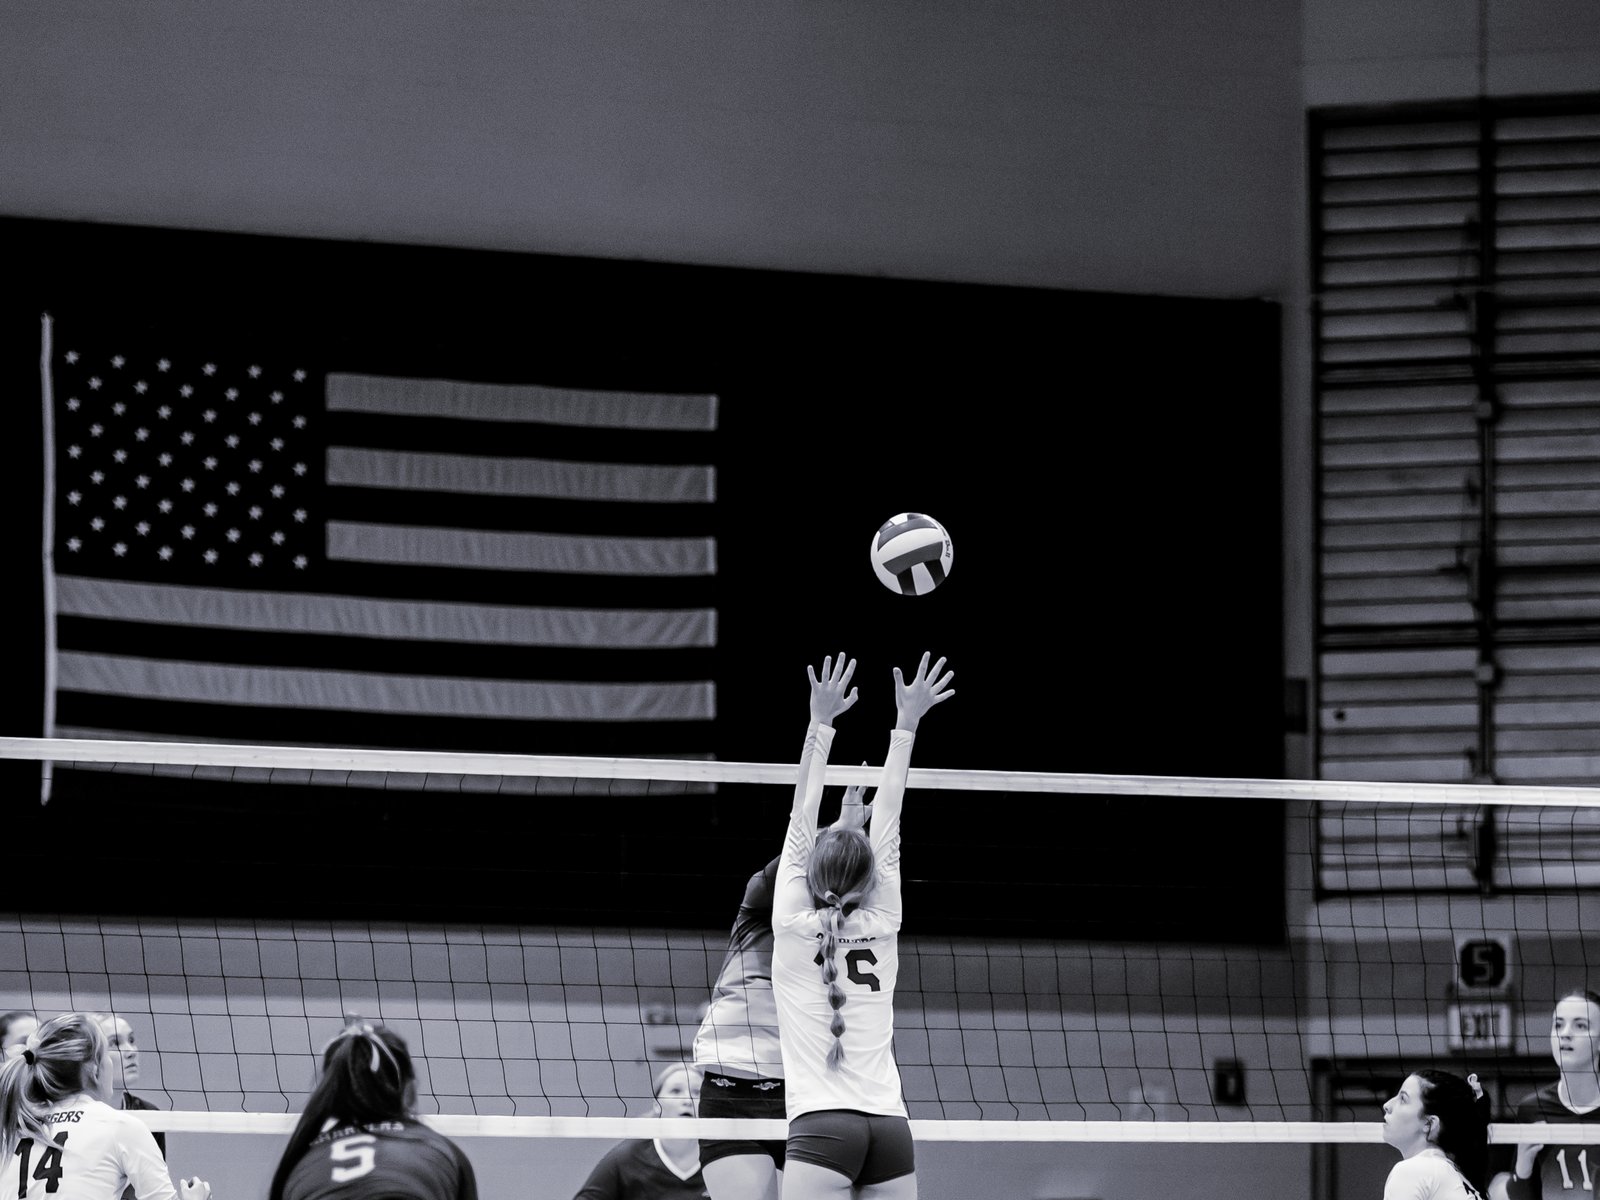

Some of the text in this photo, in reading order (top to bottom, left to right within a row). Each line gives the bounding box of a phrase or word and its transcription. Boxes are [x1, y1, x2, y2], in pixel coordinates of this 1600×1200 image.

[14, 1130, 69, 1200] 14
[330, 1134, 376, 1182] 5
[1556, 1148, 1593, 1191] 11
